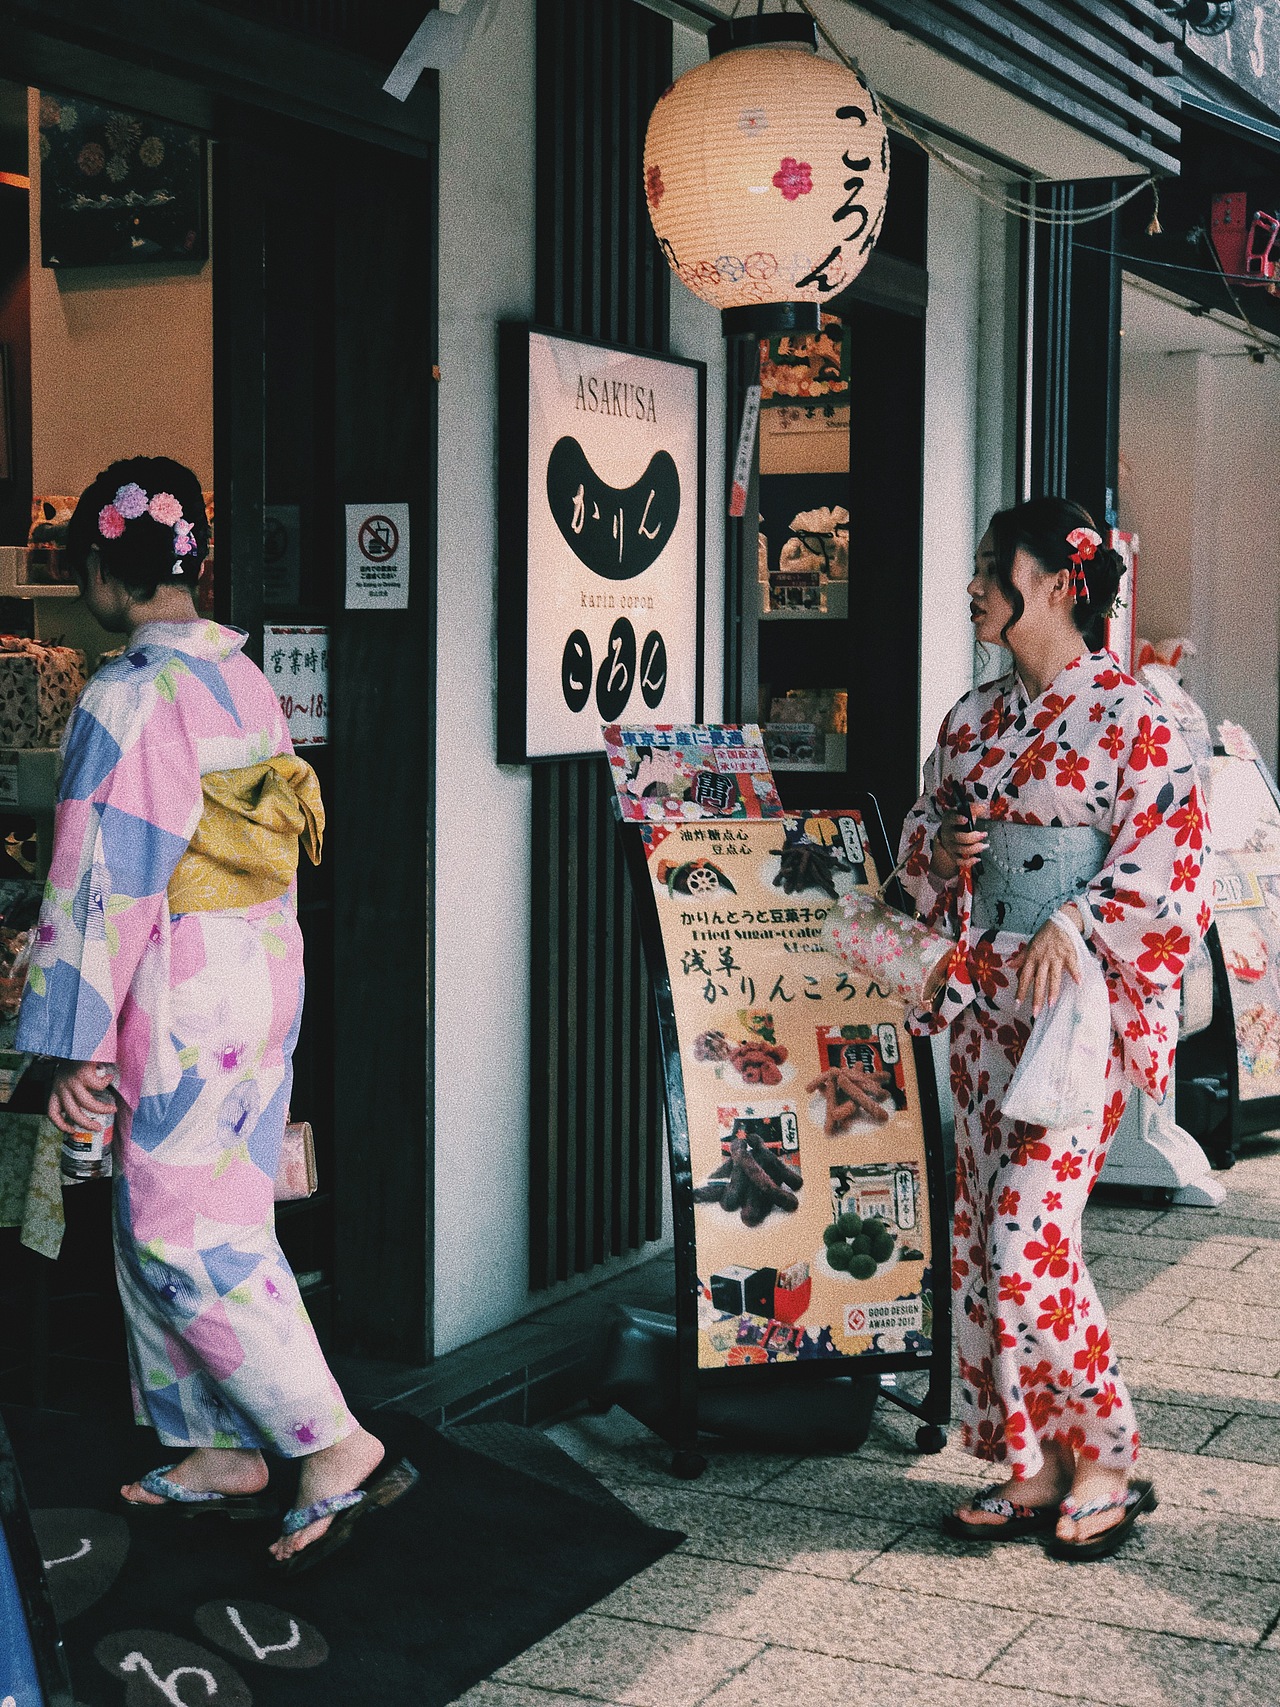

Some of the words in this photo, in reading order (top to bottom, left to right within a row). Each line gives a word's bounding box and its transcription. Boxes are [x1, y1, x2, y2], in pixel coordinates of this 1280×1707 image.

[795, 105, 872, 292] ころん
[575, 375, 658, 424] ASAKUSA
[571, 483, 662, 564] かりん
[580, 590, 615, 609] karin
[569, 636, 665, 692] ころん
[621, 731, 745, 746] 東京土産に最適
[680, 907, 831, 926] かりんとうと豆菓子の
[692, 929, 731, 941] Fried
[680, 945, 741, 978] 浅草
[702, 971, 892, 1005] かりんころん
[868, 1307, 890, 1318] GOOD
[891, 1304, 919, 1315] DESIGN
[868, 1319, 896, 1329] AWARD
[898, 1317, 916, 1327] 2012
